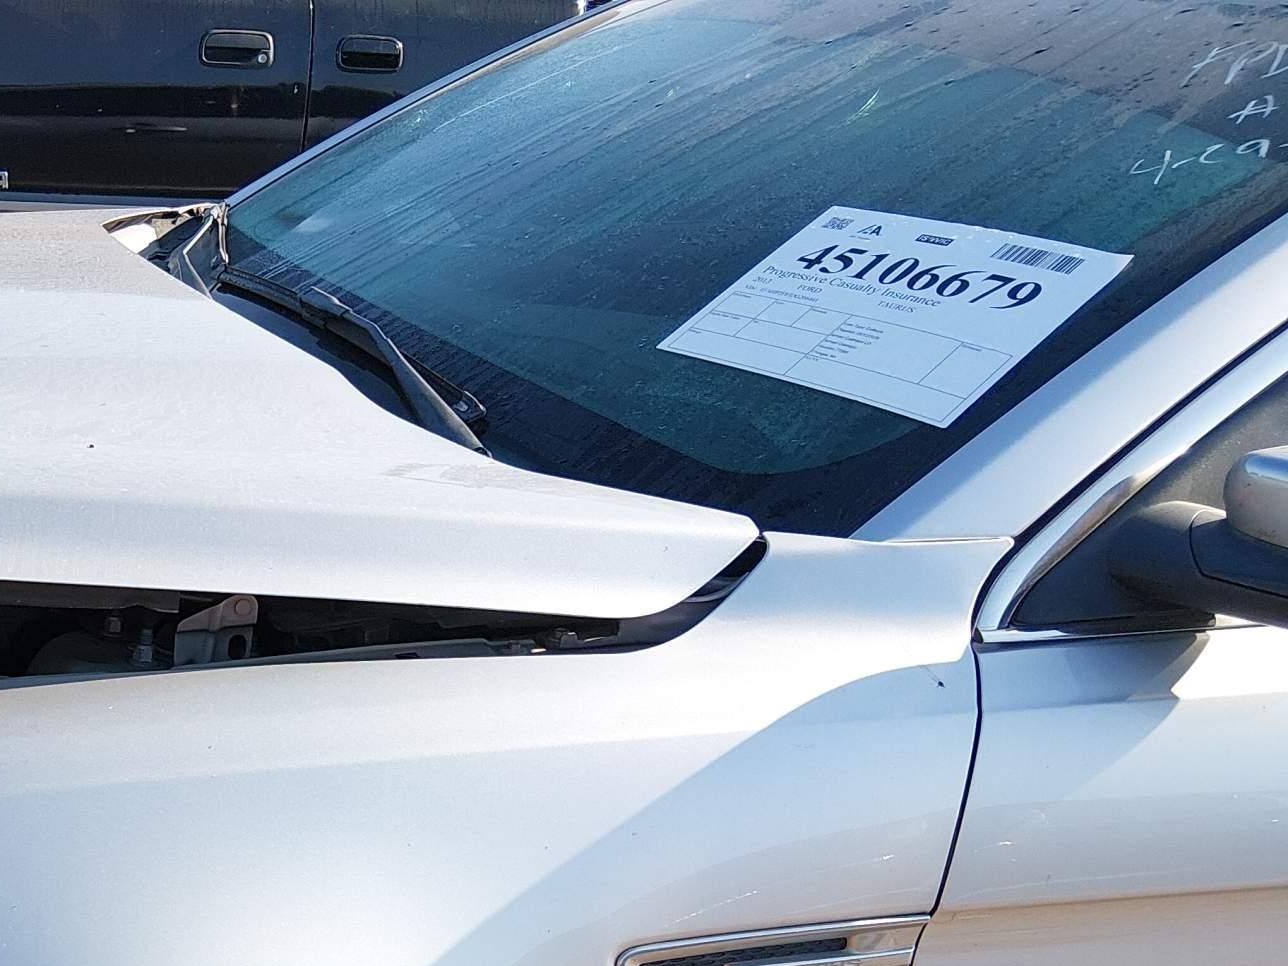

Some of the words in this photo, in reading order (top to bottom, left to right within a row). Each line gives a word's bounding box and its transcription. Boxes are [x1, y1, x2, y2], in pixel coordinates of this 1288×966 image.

[763, 265, 828, 284] Progressive
[829, 277, 880, 296] Casualty
[881, 288, 942, 307] Insurance
[796, 244, 1042, 310] 45106679
[797, 284, 823, 294] FORD
[877, 301, 917, 313] TAURUS
